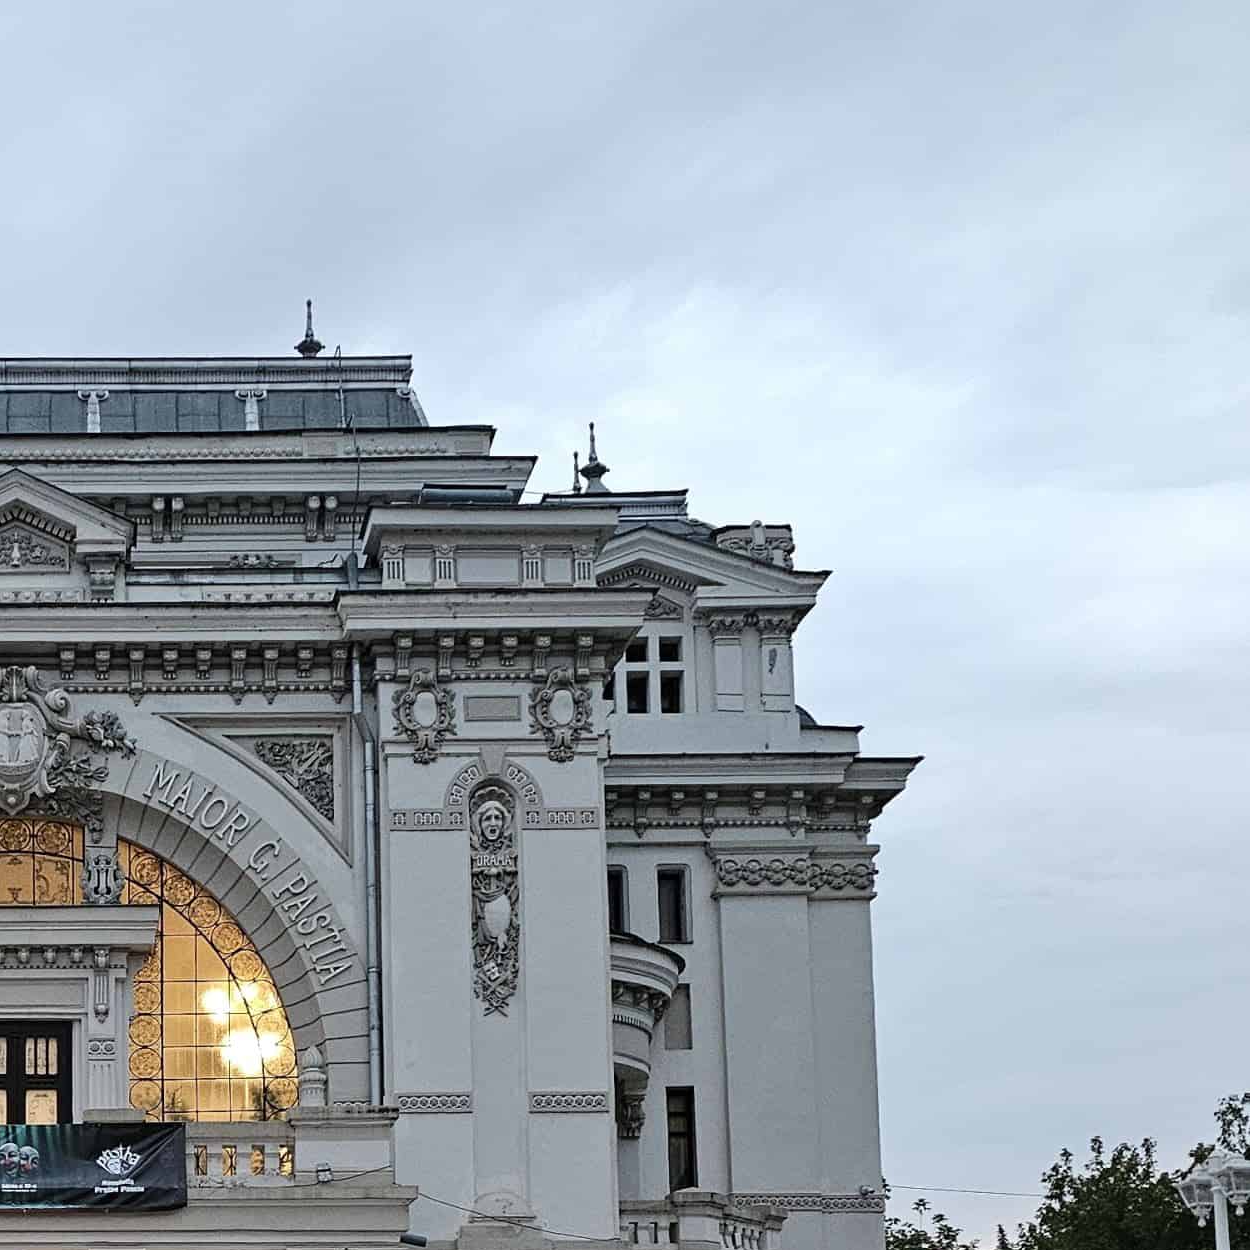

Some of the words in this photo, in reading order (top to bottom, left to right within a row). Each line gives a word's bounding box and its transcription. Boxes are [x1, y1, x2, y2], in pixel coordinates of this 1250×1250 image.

[142, 763, 250, 847] MAIOR
[249, 840, 280, 880] G.
[272, 873, 353, 985] PASTIA
